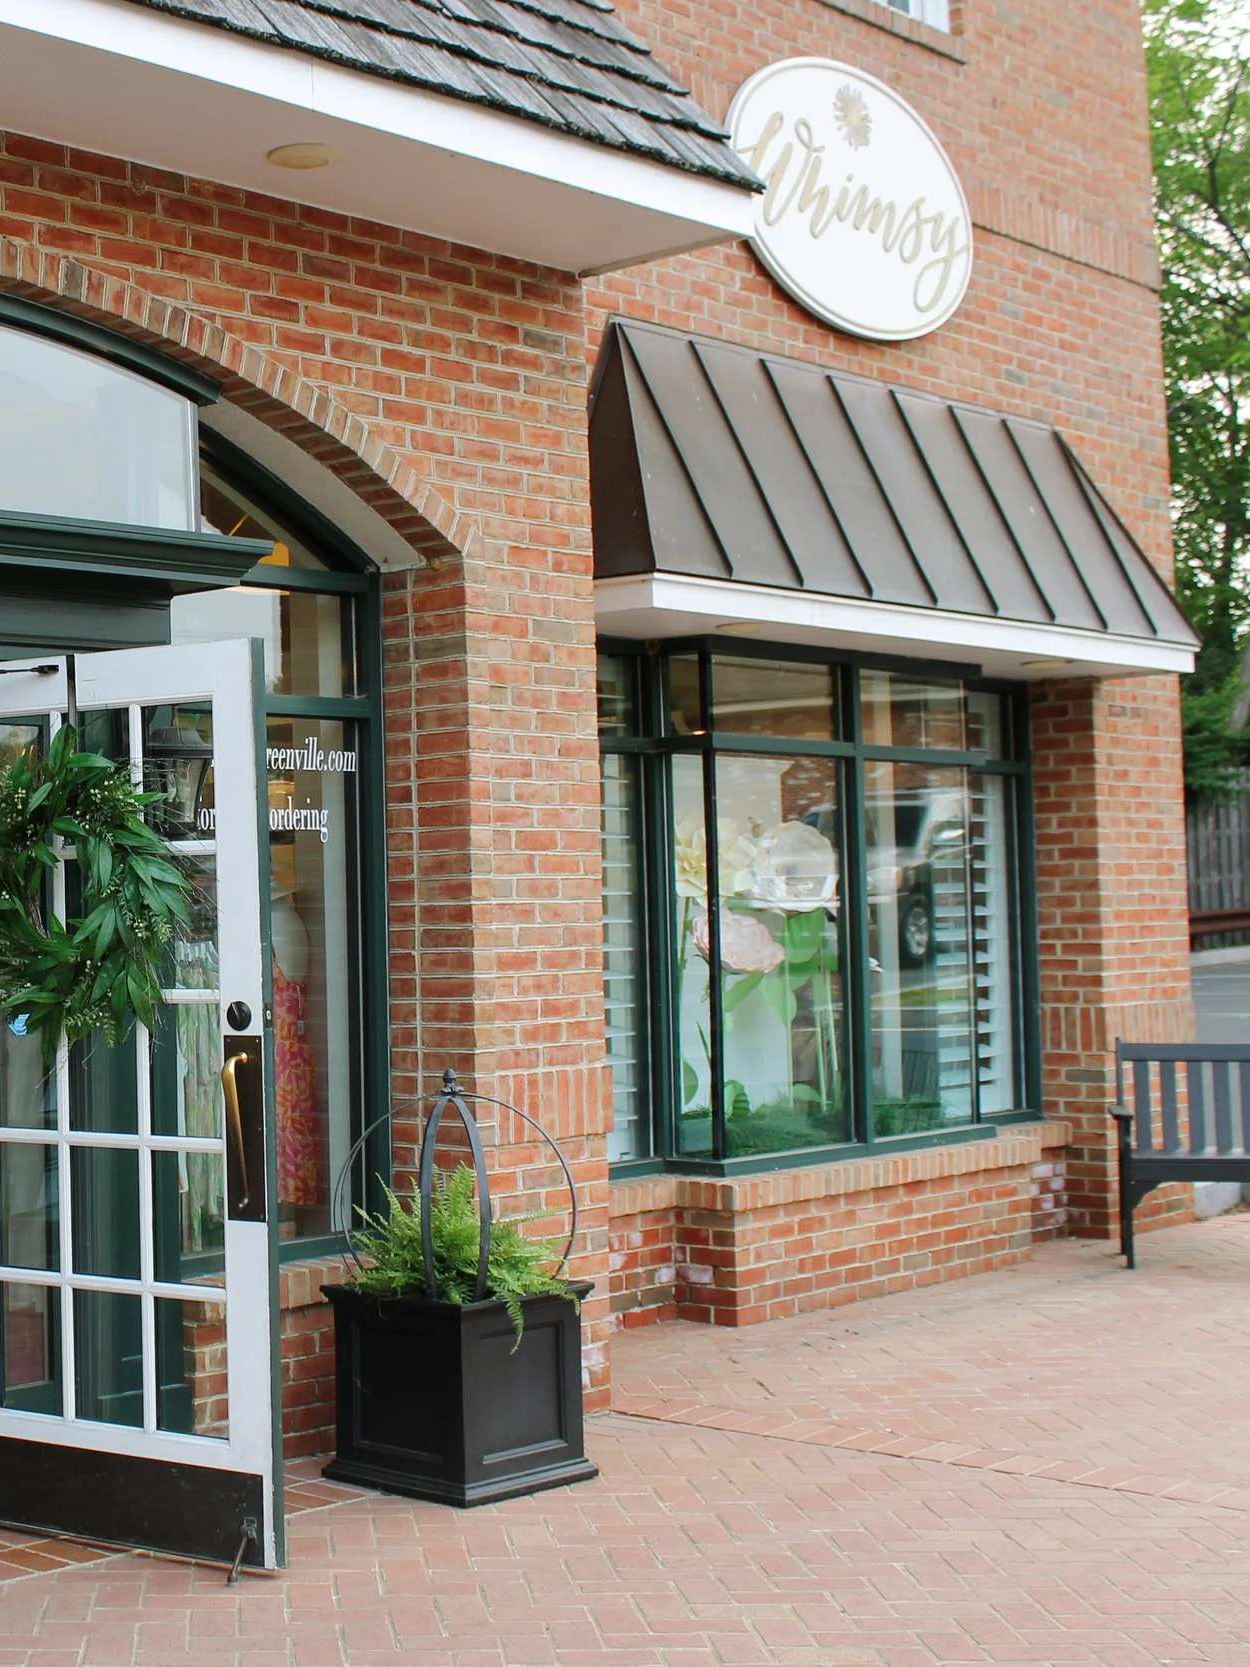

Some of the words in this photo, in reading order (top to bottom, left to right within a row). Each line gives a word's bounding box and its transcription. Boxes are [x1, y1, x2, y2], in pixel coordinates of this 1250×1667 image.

[737, 111, 970, 313] Whimsy
[266, 736, 357, 772] reenville.com
[268, 796, 329, 843] ordering
